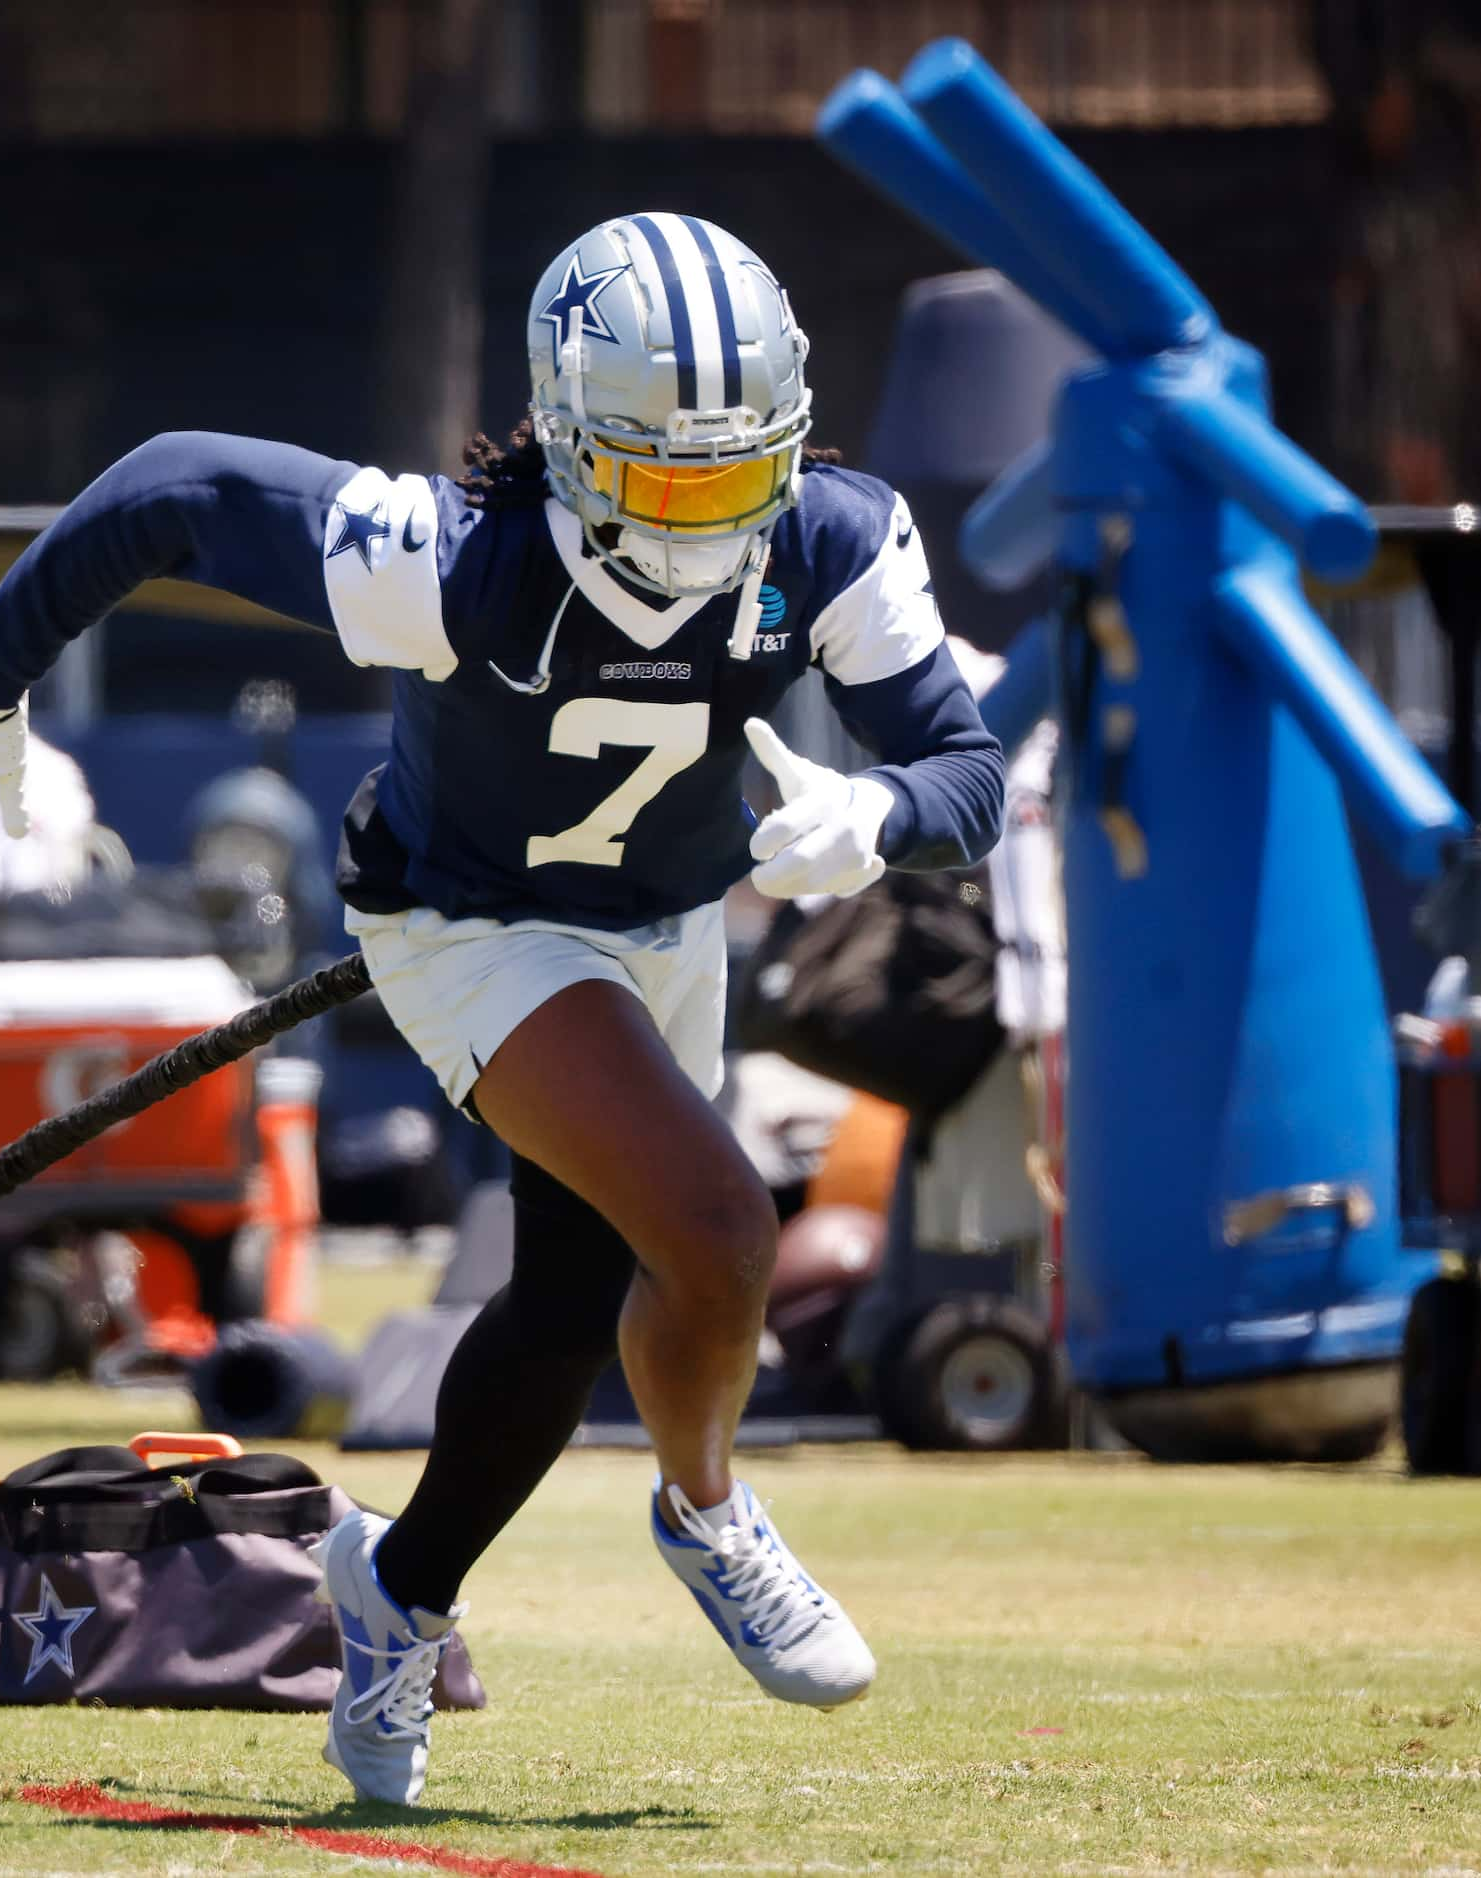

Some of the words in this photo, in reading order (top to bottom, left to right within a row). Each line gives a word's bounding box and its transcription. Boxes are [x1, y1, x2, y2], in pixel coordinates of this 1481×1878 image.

[752, 632, 791, 652] T&T
[599, 662, 692, 680] COWBOYS
[527, 697, 710, 868] 7
